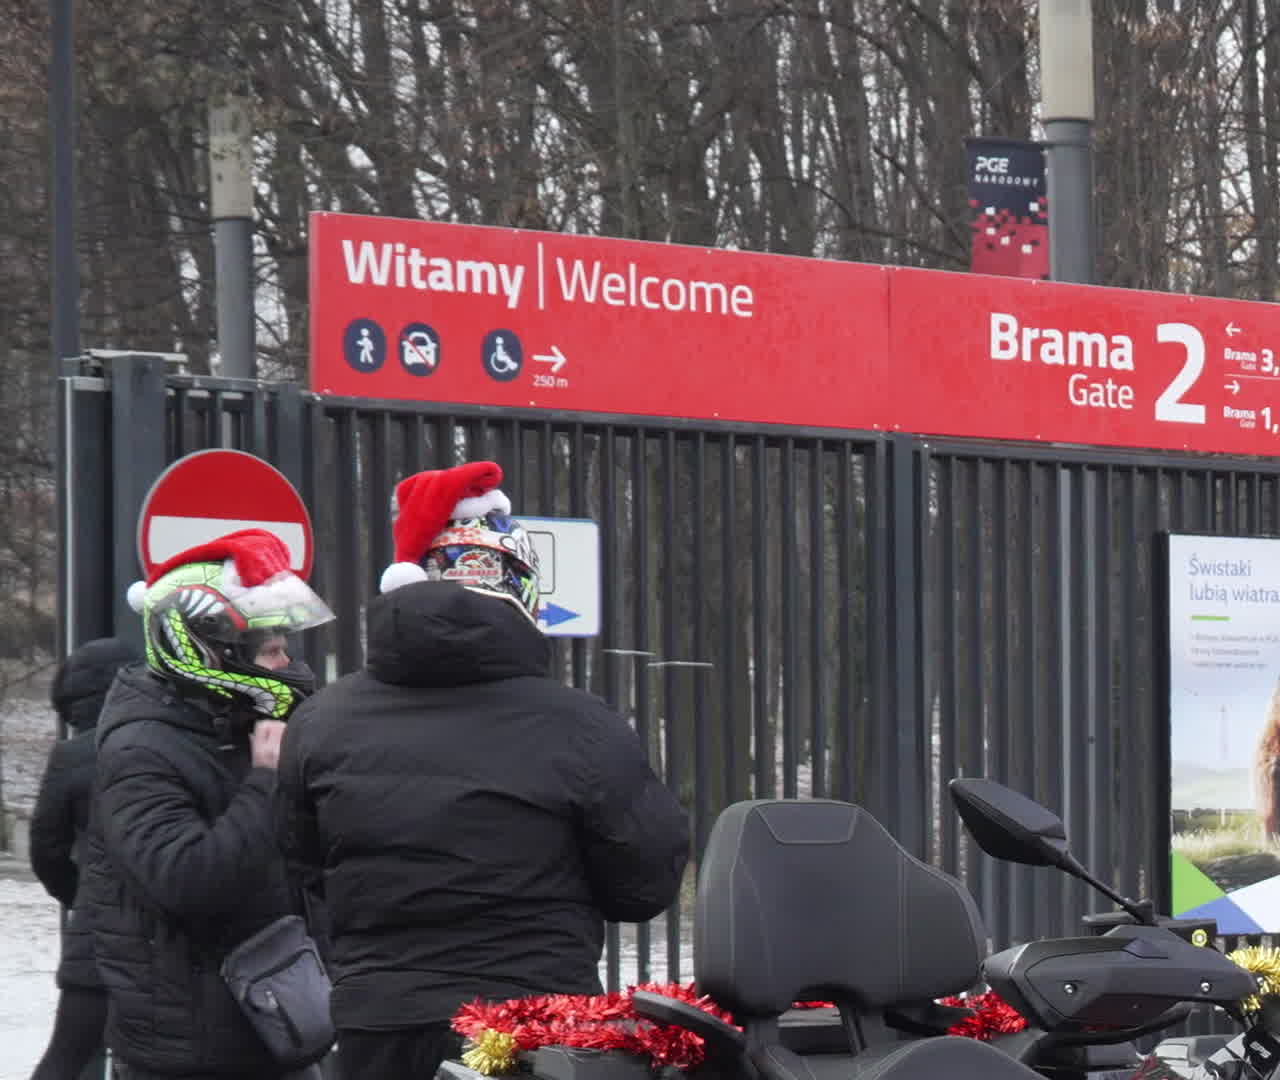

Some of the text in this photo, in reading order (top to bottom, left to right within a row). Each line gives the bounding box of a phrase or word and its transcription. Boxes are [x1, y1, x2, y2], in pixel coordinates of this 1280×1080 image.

[975, 155, 1009, 173] PGE
[975, 174, 1039, 187] NARODOWY
[342, 239, 755, 317] Witamy Welcome
[1223, 347, 1257, 362] Brama
[990, 312, 1207, 425] Brama 2
[533, 374, 569, 389] 250 m
[1068, 373, 1135, 410] Gate
[1223, 405, 1257, 420] Brama
[1189, 552, 1252, 577] Świstaki
[1189, 582, 1229, 607] lubią
